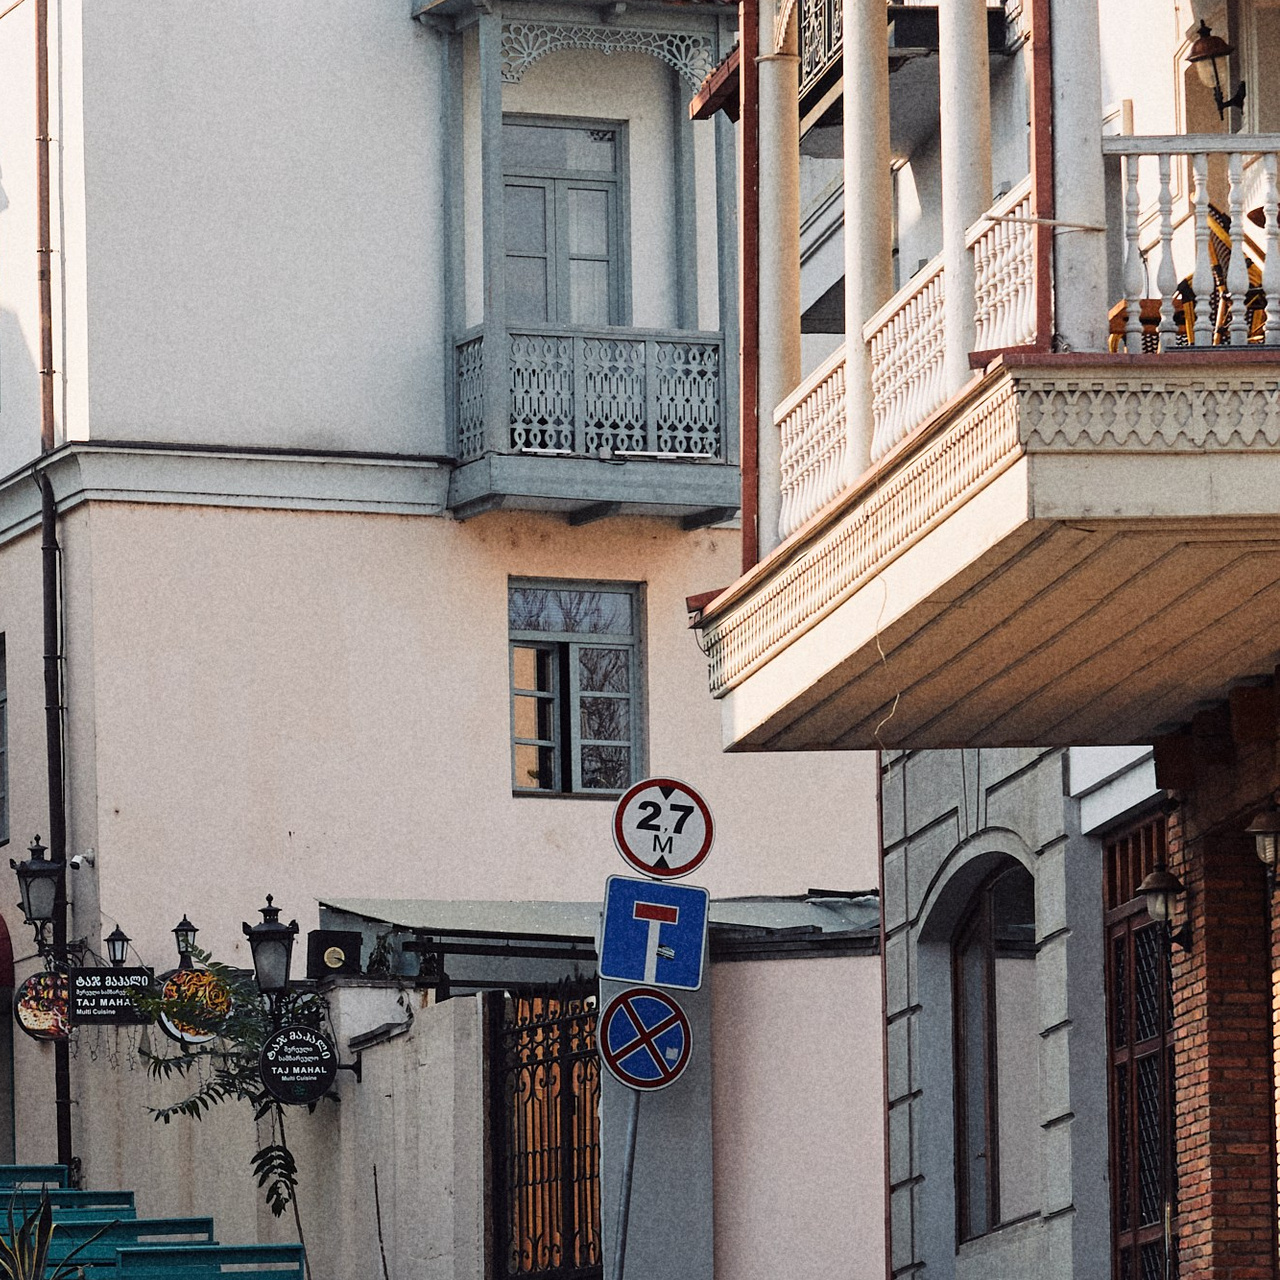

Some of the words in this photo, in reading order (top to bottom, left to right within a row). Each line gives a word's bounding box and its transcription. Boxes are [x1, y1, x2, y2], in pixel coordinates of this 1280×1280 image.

[636, 801, 694, 834] 2,7
[76, 998, 96, 1006] TAJ
[292, 1066, 327, 1074] MAHAL
